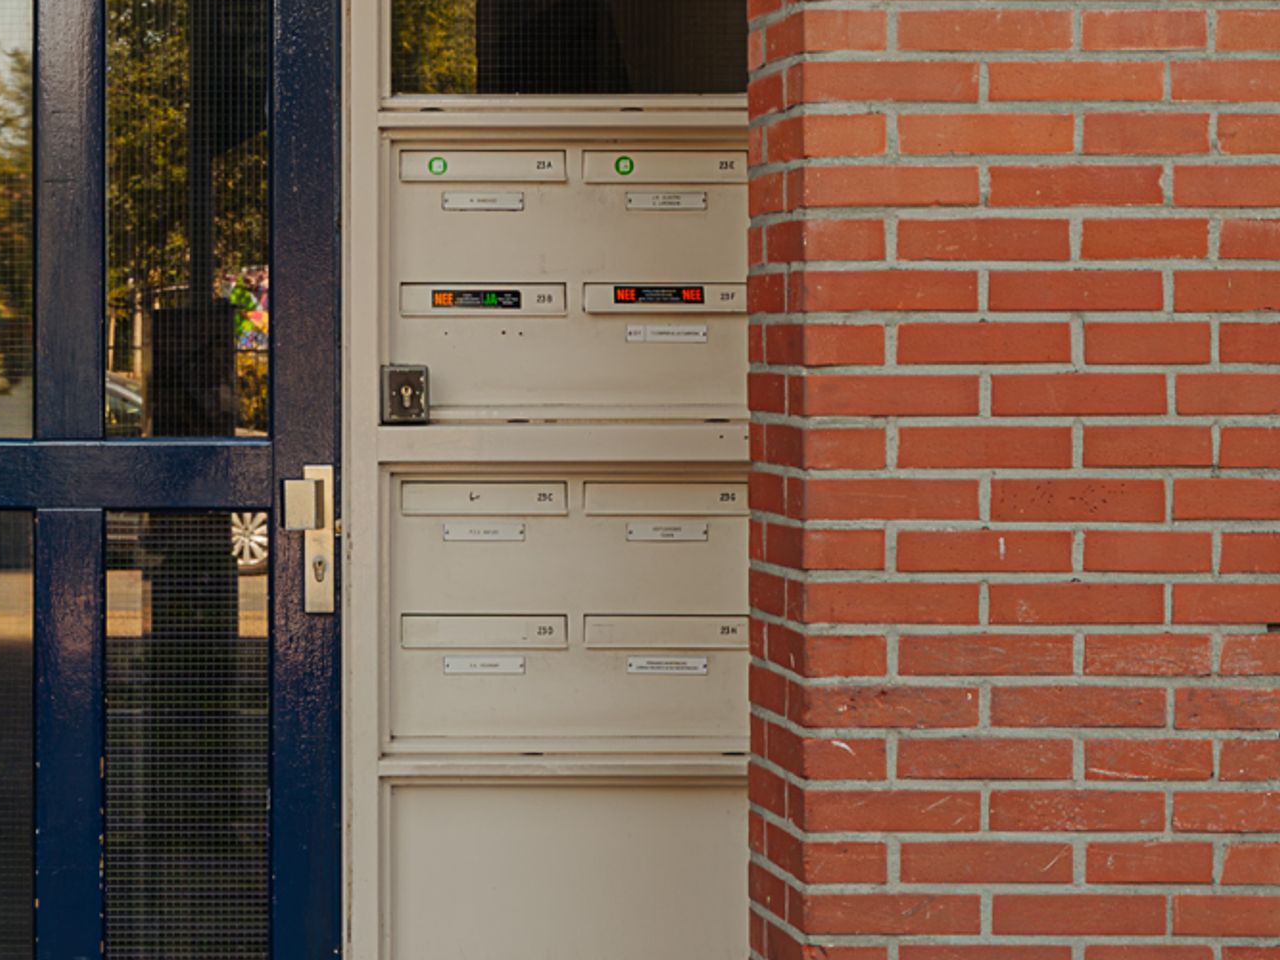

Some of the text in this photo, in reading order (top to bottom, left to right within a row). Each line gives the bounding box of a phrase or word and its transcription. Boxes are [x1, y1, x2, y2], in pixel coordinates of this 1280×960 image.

[433, 292, 454, 306] NEE
[484, 292, 498, 306] JA
[616, 288, 637, 301] NEE
[682, 288, 702, 301] NEE
